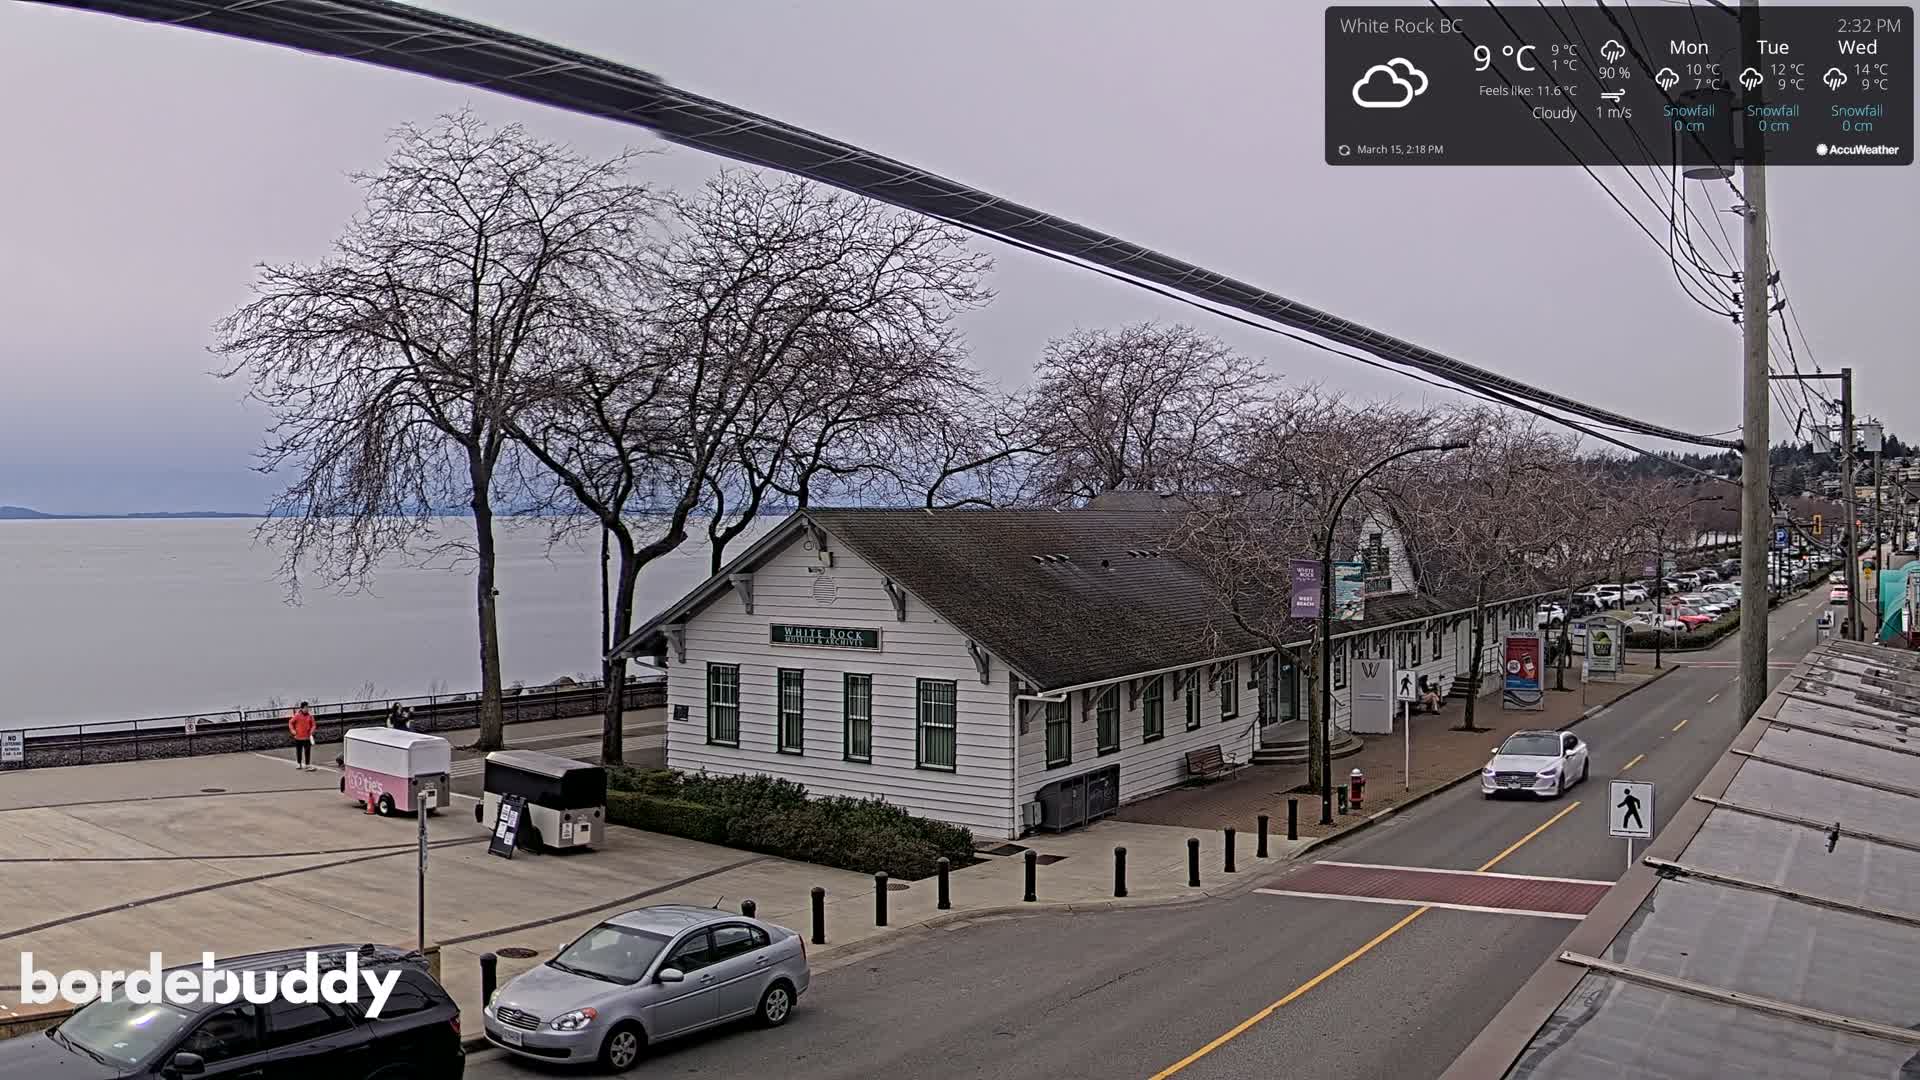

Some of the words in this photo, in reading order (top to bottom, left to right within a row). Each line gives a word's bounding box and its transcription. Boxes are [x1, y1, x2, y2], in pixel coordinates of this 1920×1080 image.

[785, 627, 823, 637] WHITE
[829, 628, 864, 640] ROCK
[784, 636, 815, 644] MUSEUM
[825, 638, 864, 647] ARCHIVES
